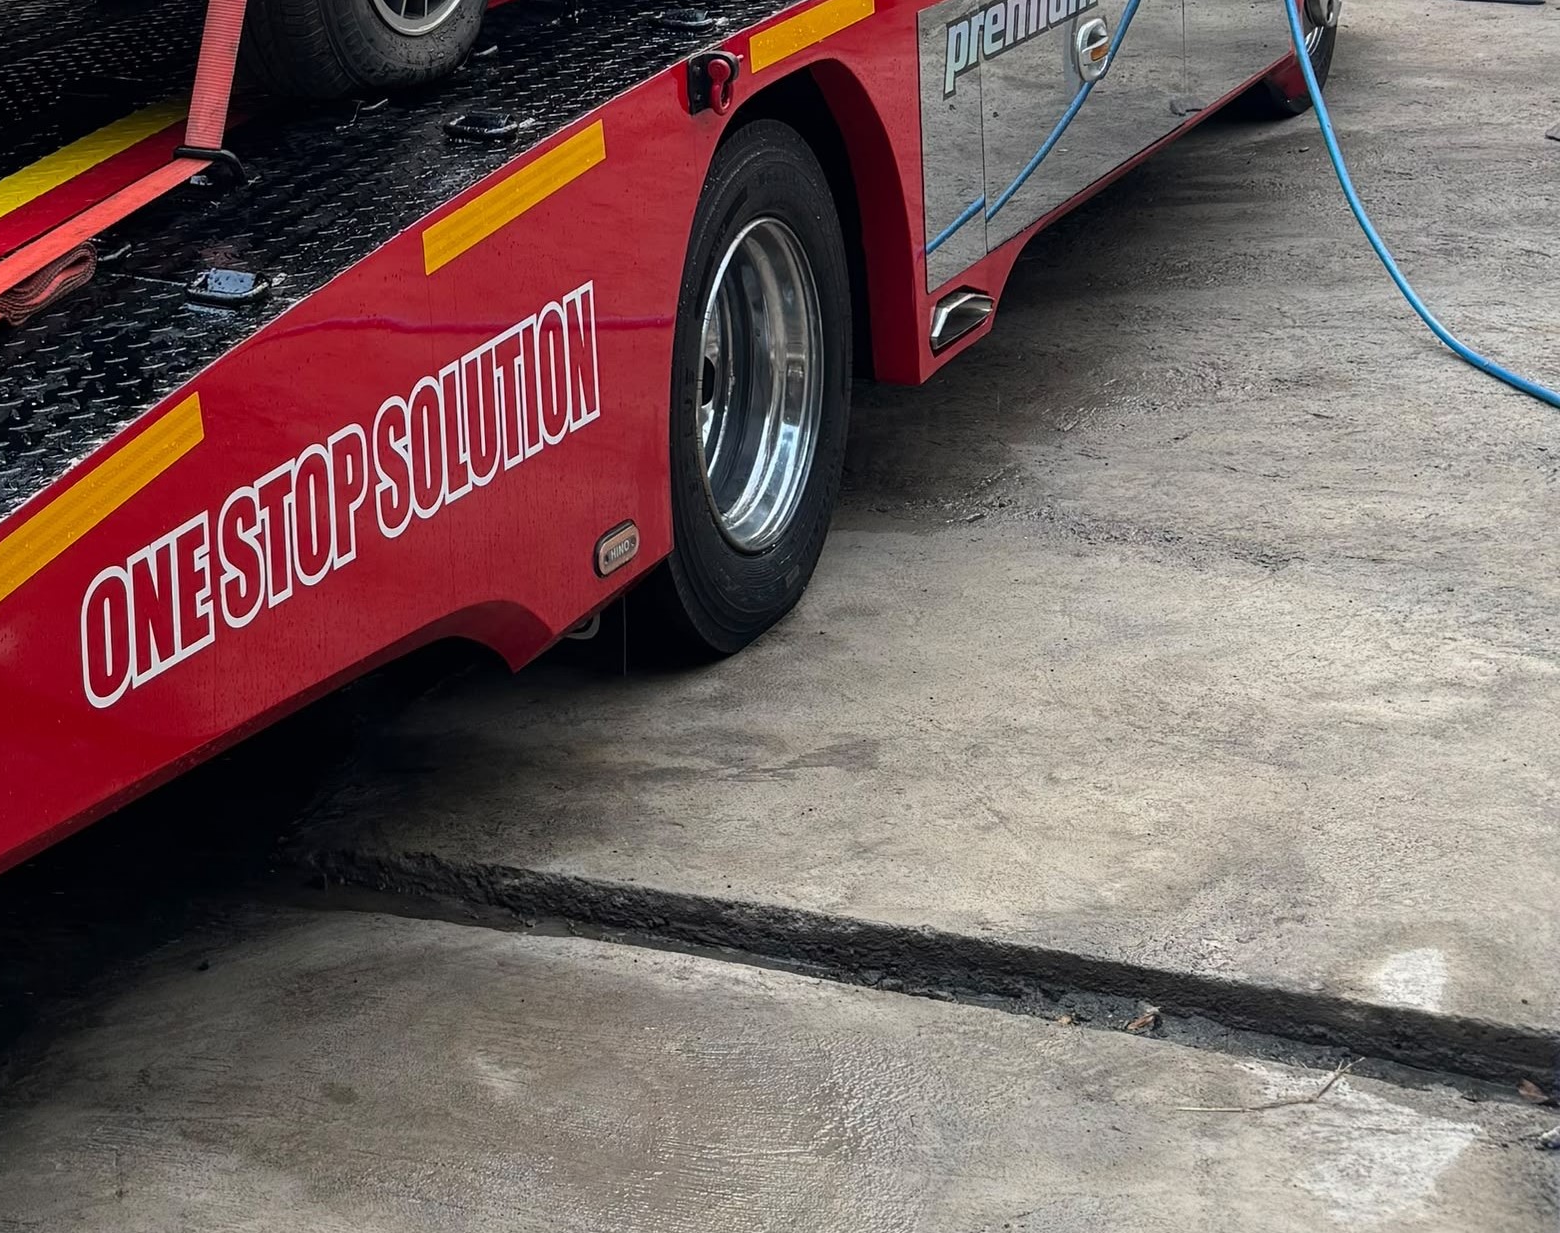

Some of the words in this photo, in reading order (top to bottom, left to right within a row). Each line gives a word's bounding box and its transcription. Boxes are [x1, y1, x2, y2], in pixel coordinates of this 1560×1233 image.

[81, 511, 215, 709] ONE
[218, 422, 368, 629] STOP
[373, 280, 602, 539] SOLUTION
[610, 539, 630, 561] HINO
